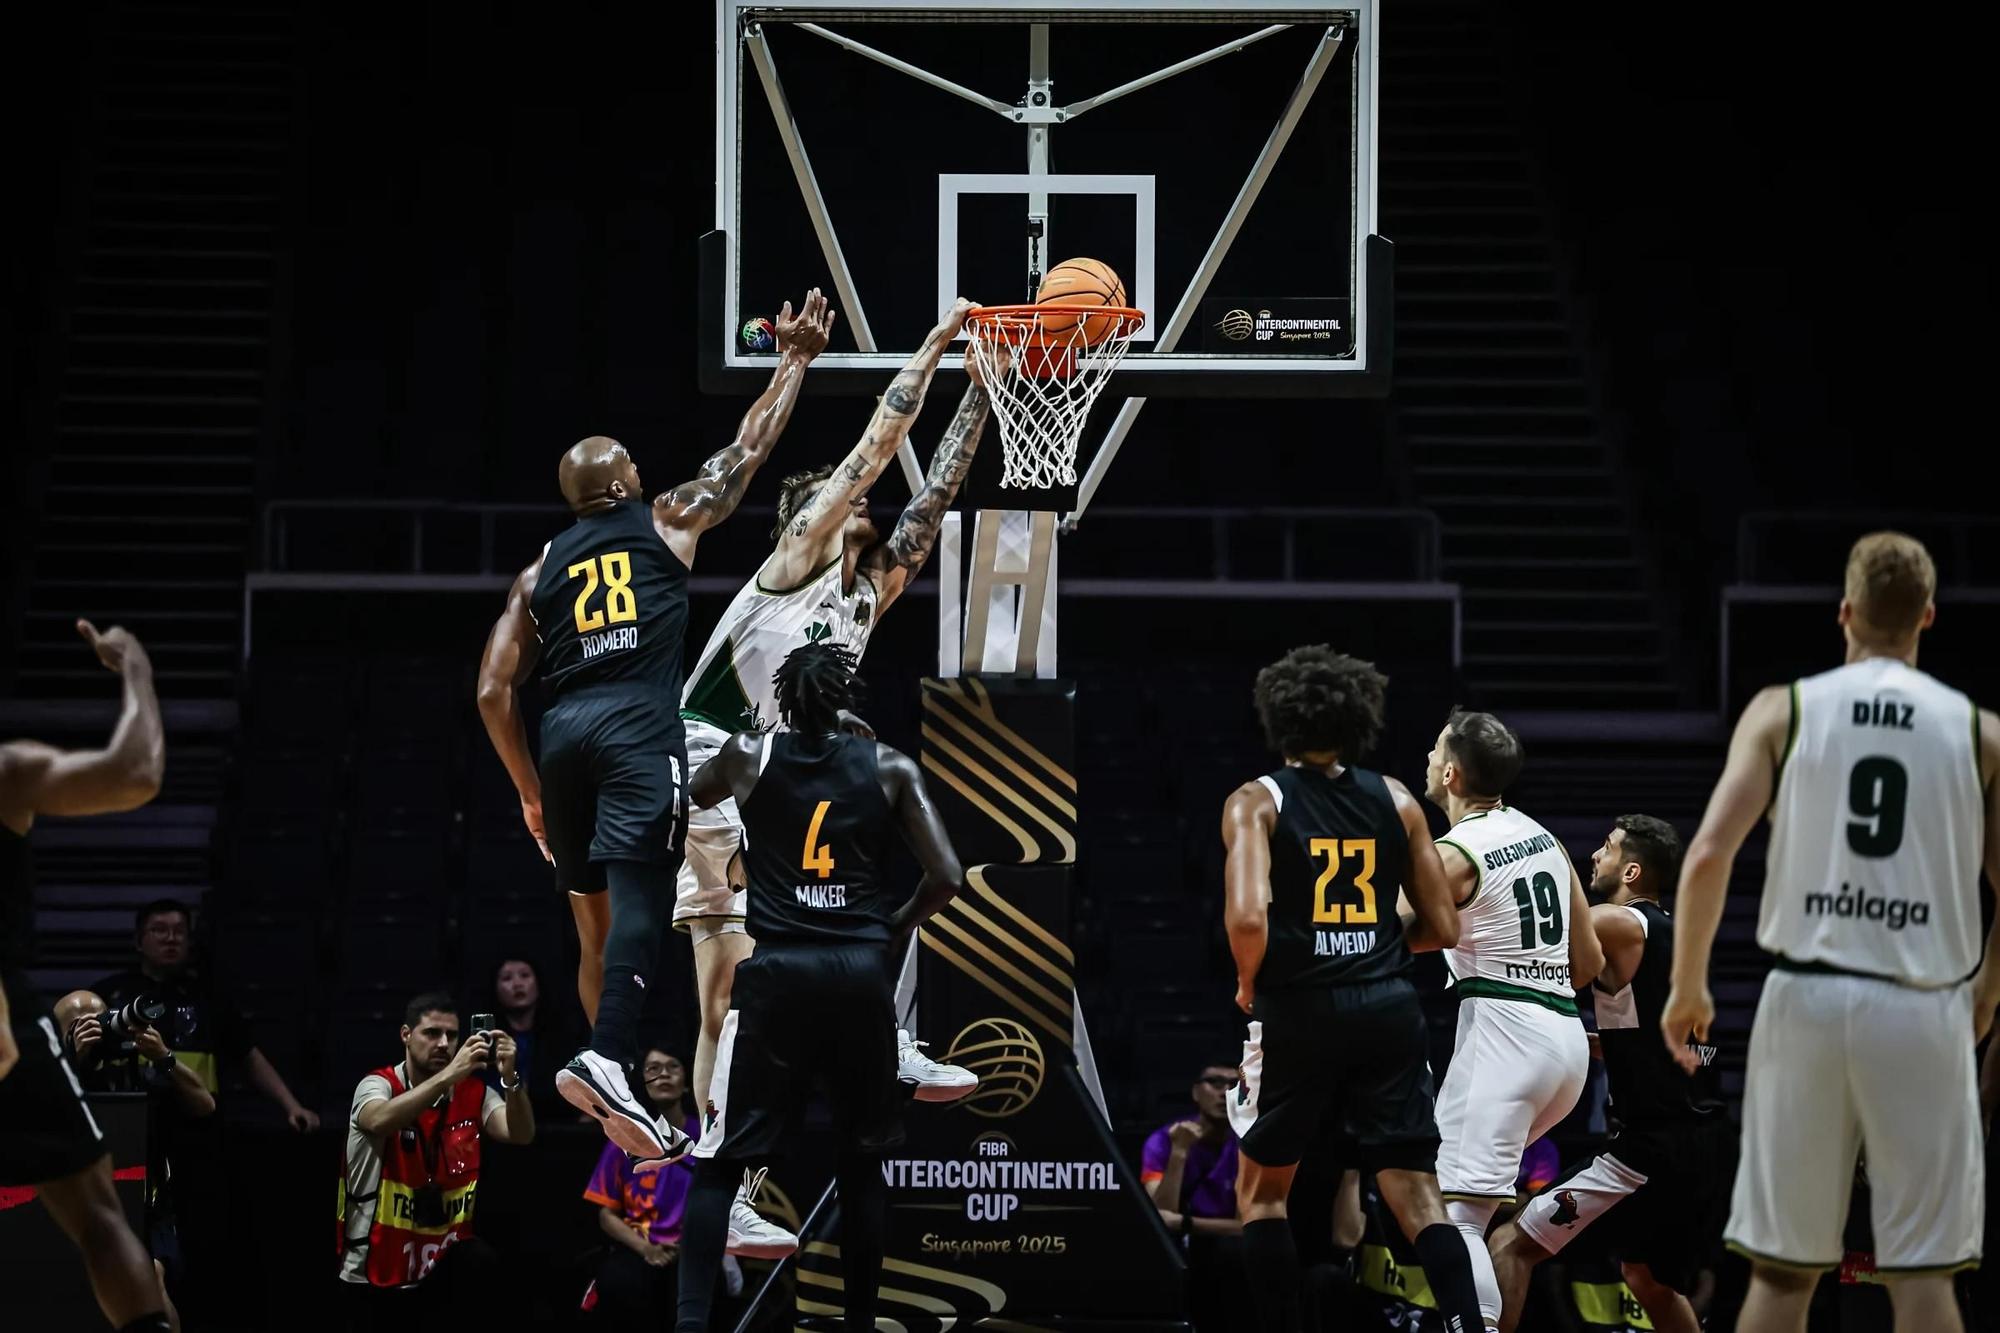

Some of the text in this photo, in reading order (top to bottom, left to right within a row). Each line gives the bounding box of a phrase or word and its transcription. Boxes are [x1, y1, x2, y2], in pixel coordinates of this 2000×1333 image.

[1255, 319, 1341, 330] INTERCONTINENTAL
[1255, 330, 1274, 340] CUP
[1279, 331, 1331, 342] Singapore 2025
[567, 551, 638, 634] 28
[580, 626, 638, 659] ROMERO
[1852, 695, 1915, 730] DÍAZ
[1846, 755, 1908, 861] 9
[802, 801, 835, 878] 4
[795, 884, 847, 908] MAKER
[1309, 838, 1378, 924] 23
[1512, 871, 1564, 951] 19
[1313, 930, 1377, 956] ALMEIDA
[978, 1141, 1009, 1157] FIBA
[881, 1159, 1121, 1191] NTERCONTINENTAL
[966, 1193, 1020, 1223] CUP
[920, 1232, 1068, 1262] Singapore 2025
